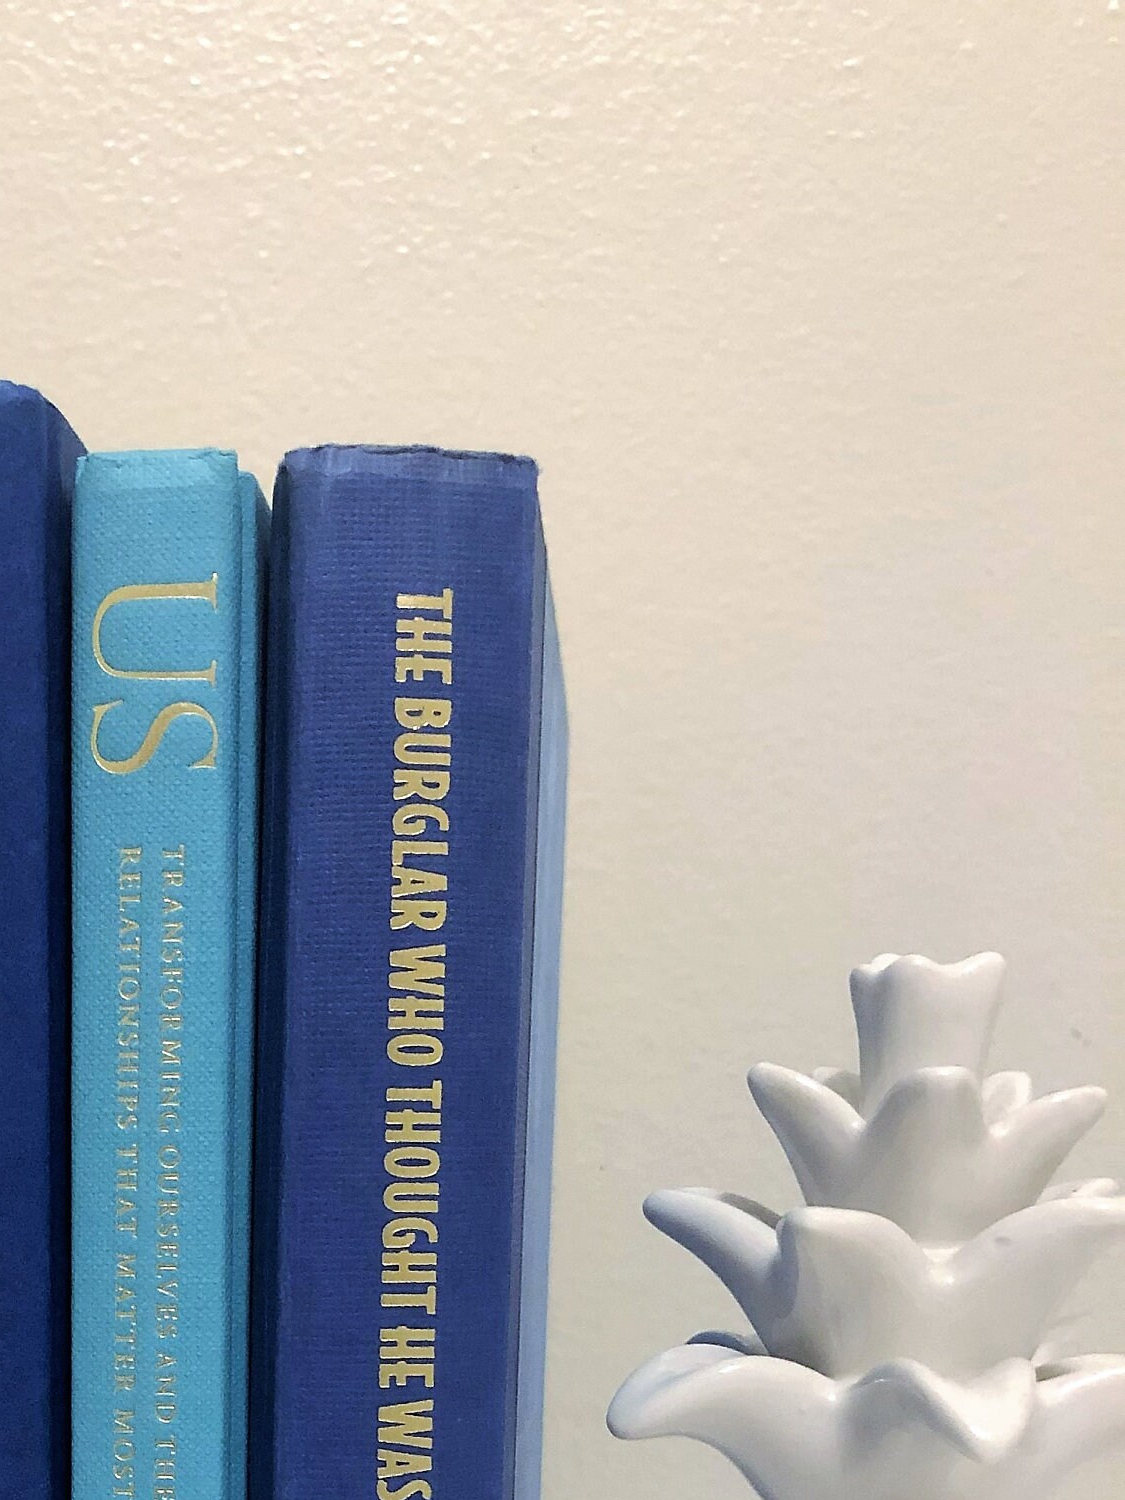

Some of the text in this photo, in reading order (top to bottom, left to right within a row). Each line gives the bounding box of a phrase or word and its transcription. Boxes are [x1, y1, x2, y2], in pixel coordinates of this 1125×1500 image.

[91, 573, 219, 775] US
[395, 587, 453, 685] THE
[389, 697, 452, 931] BURGLAR
[158, 844, 186, 1133] TRANSFORMING
[387, 944, 446, 1067] WHO
[112, 846, 143, 1499] RELATIONSHIPS THAT MATTER MOST
[155, 1144, 180, 1339] OURSELVES
[380, 1079, 443, 1315] THOUGHT
[155, 1352, 177, 1424] AND
[379, 1325, 436, 1389] HE
